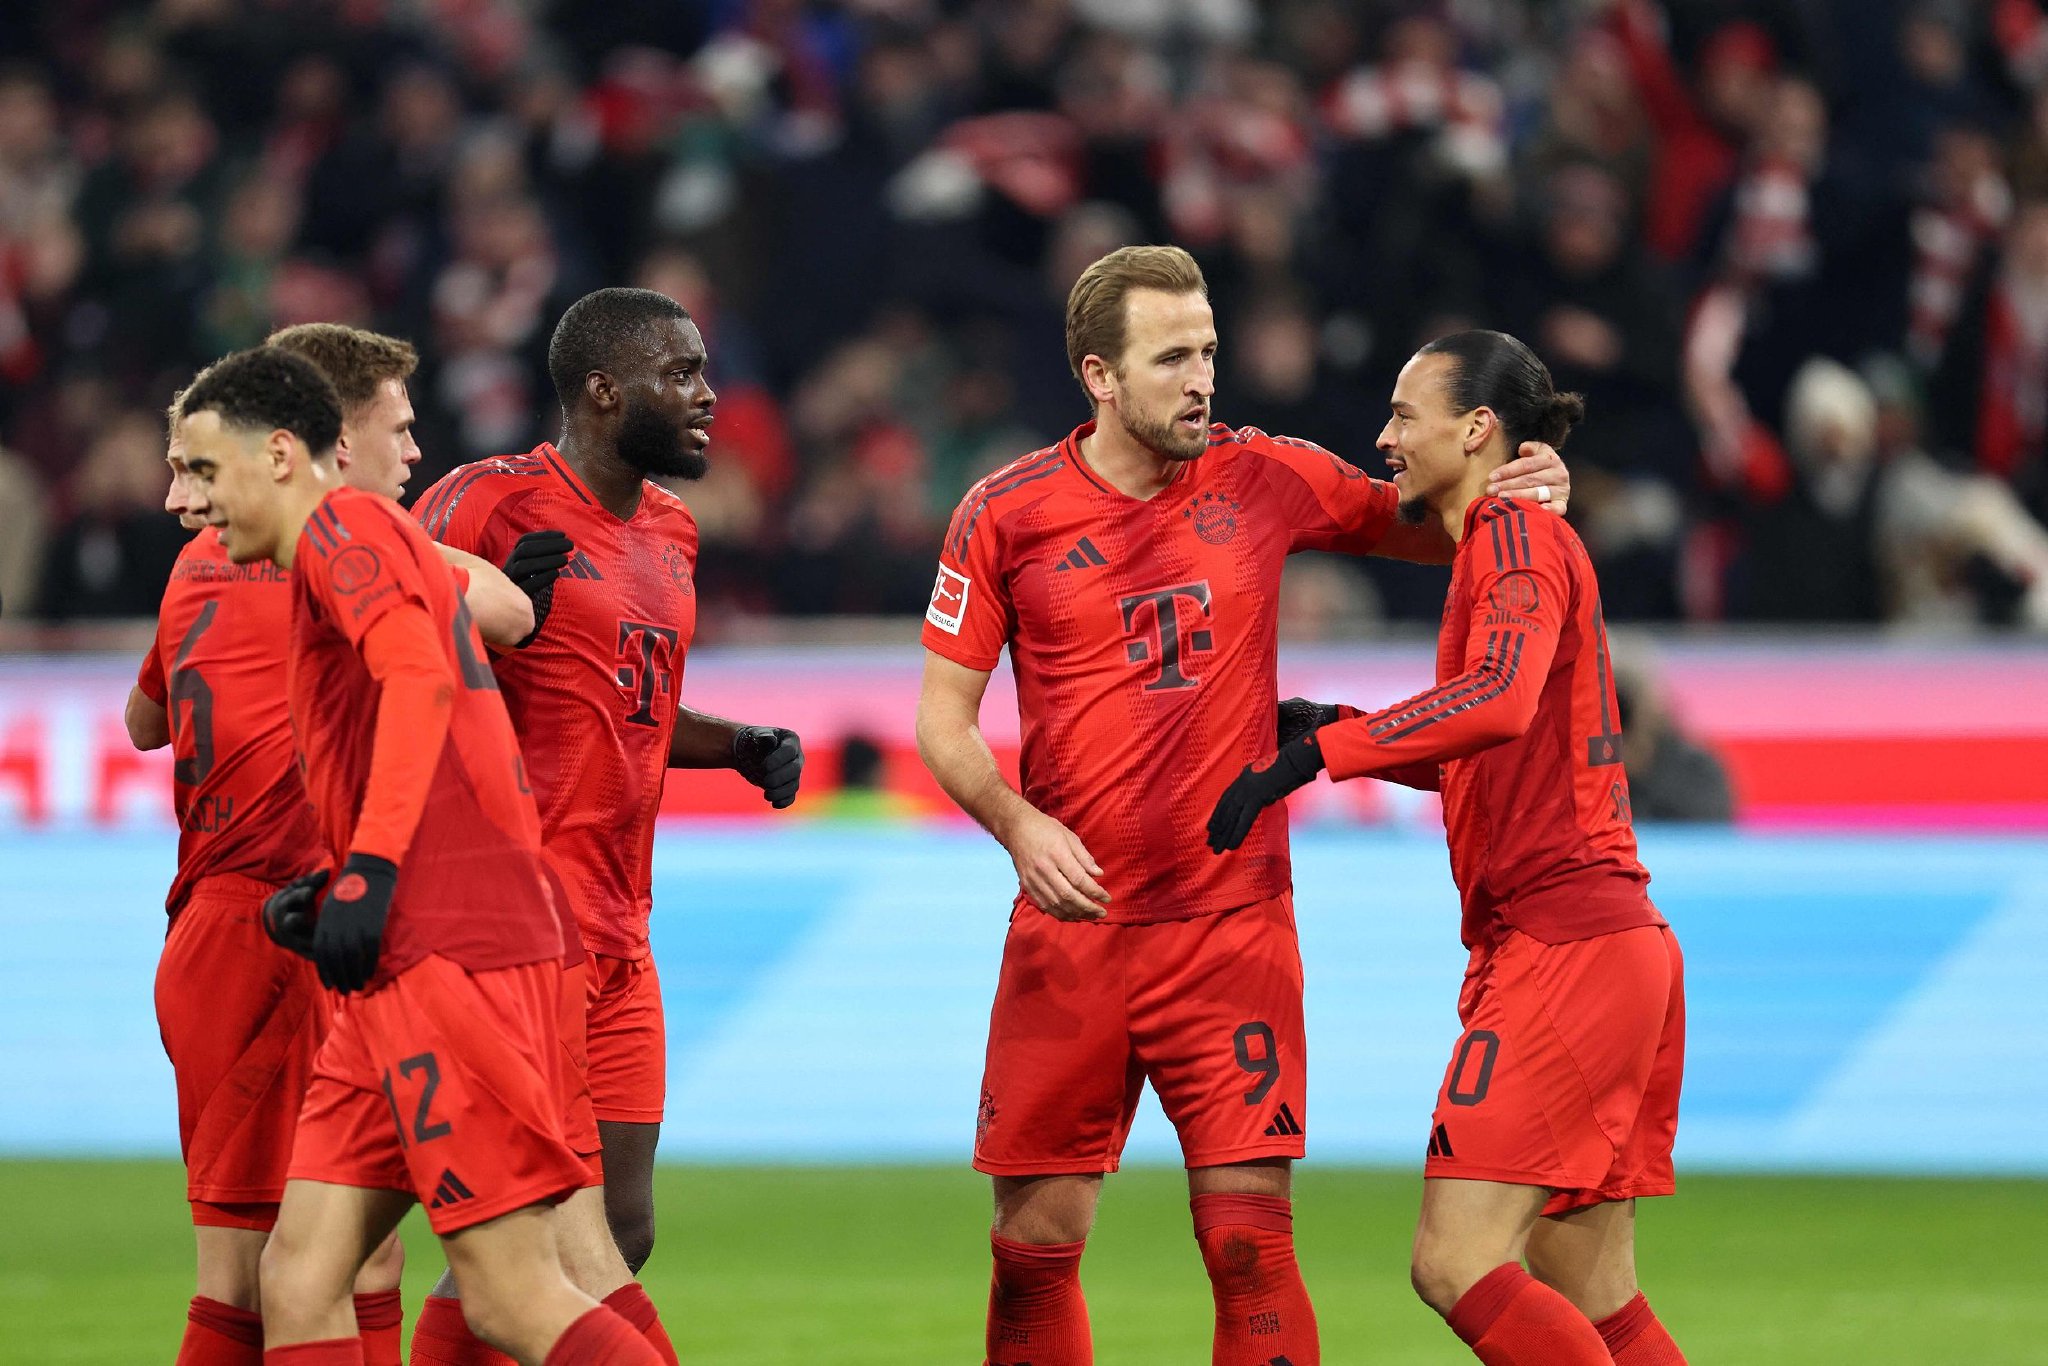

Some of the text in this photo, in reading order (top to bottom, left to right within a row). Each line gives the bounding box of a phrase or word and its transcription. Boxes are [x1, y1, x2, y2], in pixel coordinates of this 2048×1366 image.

[1484, 611, 1540, 632] Allianz
[1232, 1020, 1281, 1107] 9
[1446, 1029, 1501, 1107] 0
